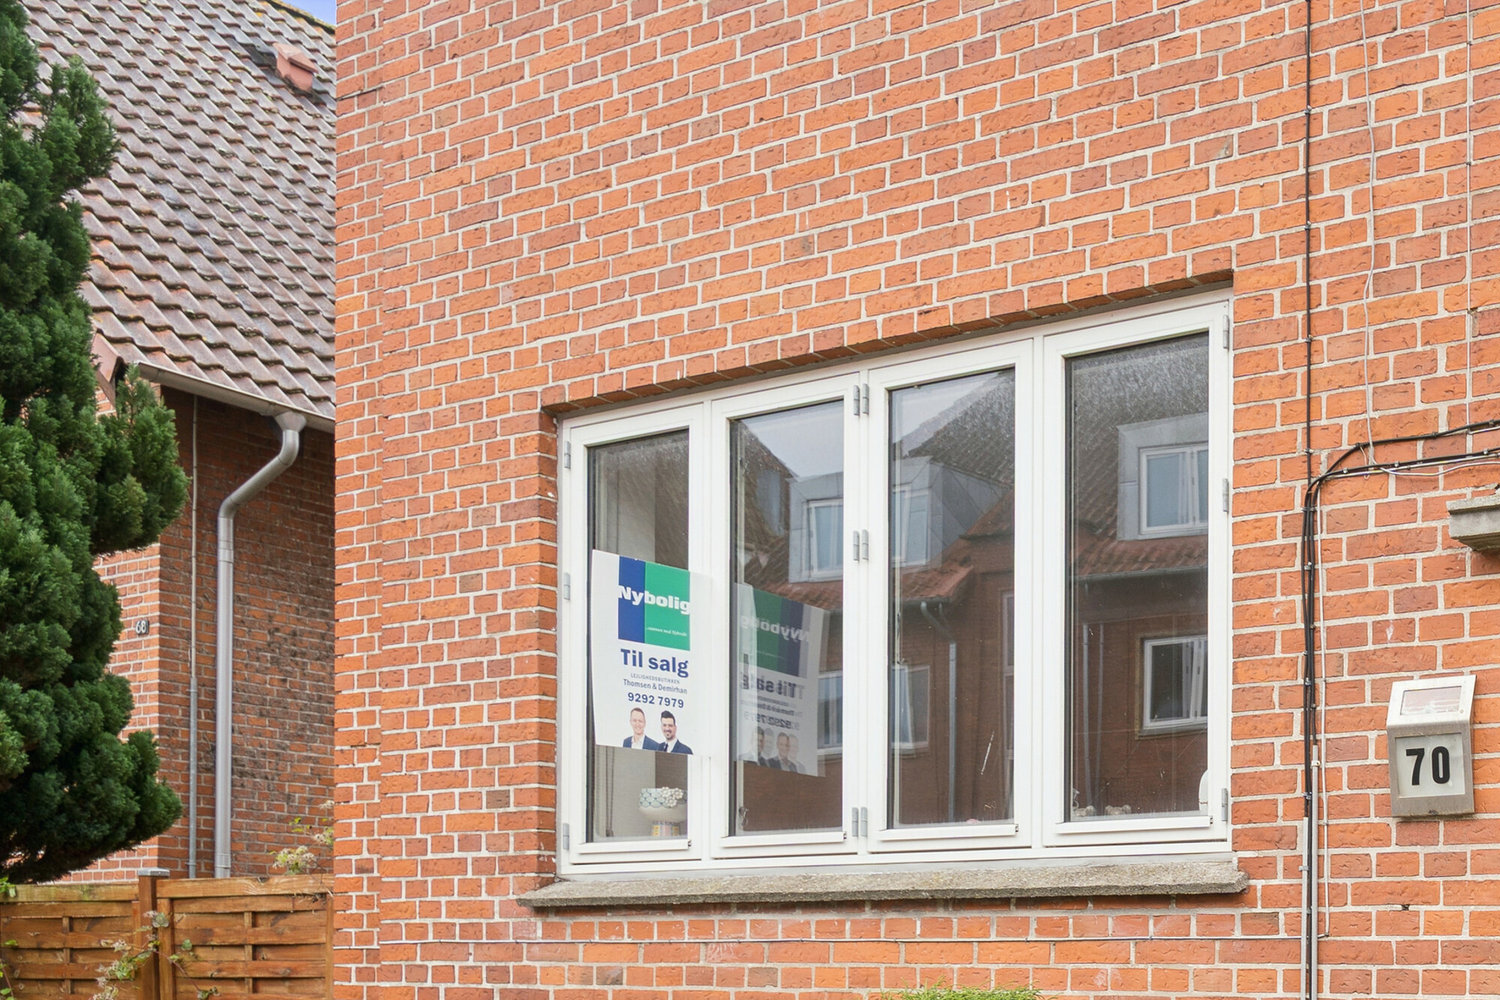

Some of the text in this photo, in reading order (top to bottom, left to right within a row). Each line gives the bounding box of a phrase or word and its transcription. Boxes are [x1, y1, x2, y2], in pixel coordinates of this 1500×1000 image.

[617, 585, 691, 615] Nybolig
[135, 620, 147, 634] 68
[620, 648, 689, 679] Til salg
[623, 678, 652, 690] Thomsen
[658, 683, 688, 695] Demirhan
[627, 692, 685, 709] 9292 7979
[1405, 746, 1451, 786] 70
